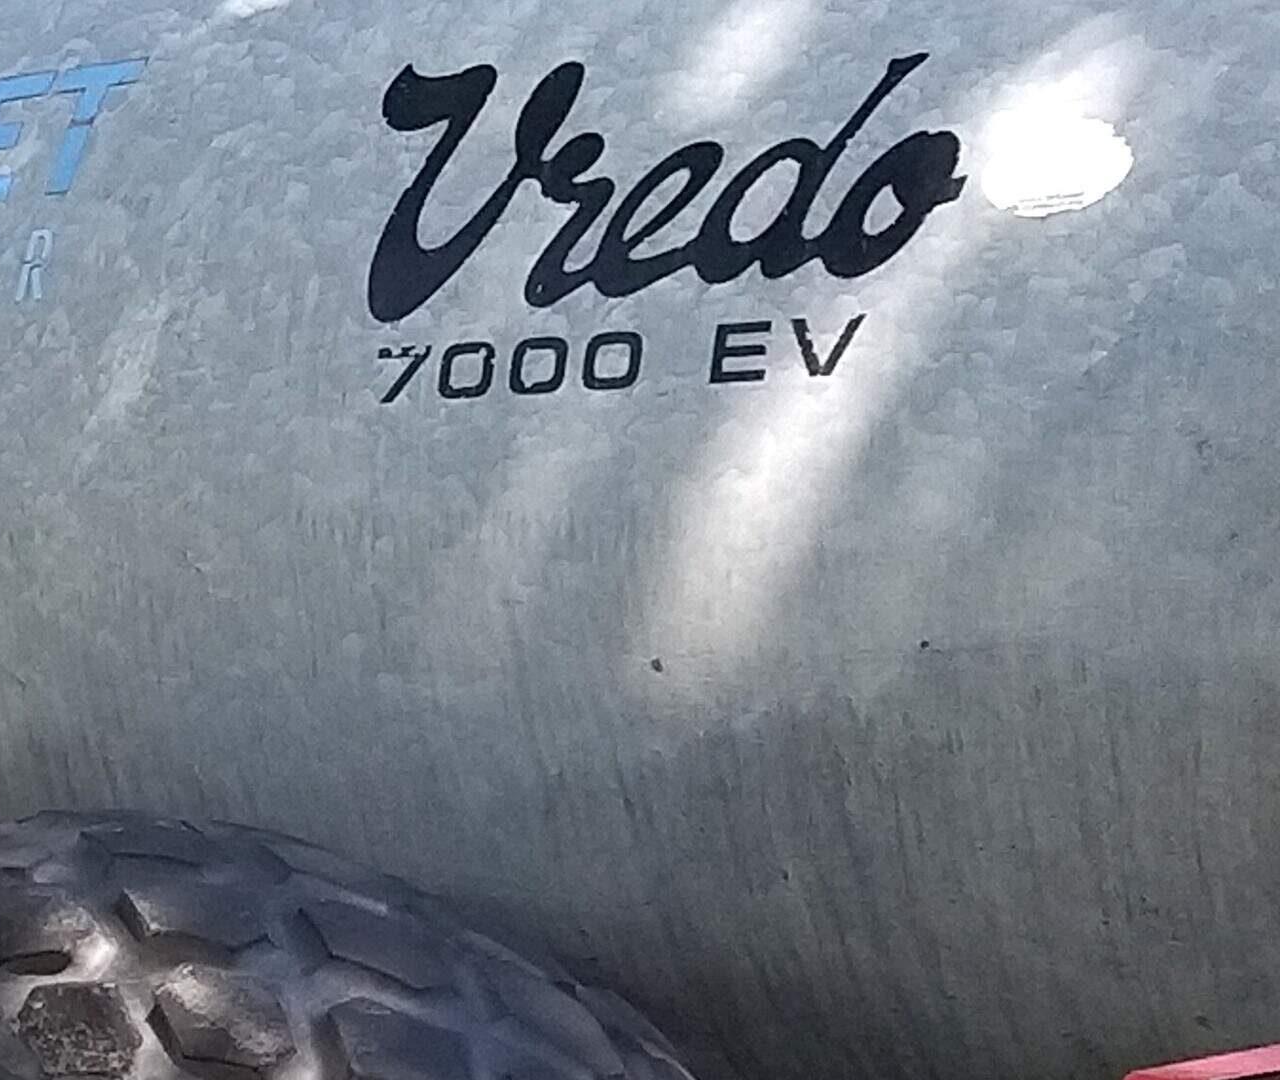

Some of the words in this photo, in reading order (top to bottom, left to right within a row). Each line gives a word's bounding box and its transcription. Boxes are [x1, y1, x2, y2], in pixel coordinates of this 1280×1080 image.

[368, 51, 968, 323] Vredo
[378, 330, 642, 403] 7000
[708, 313, 867, 384] EV
